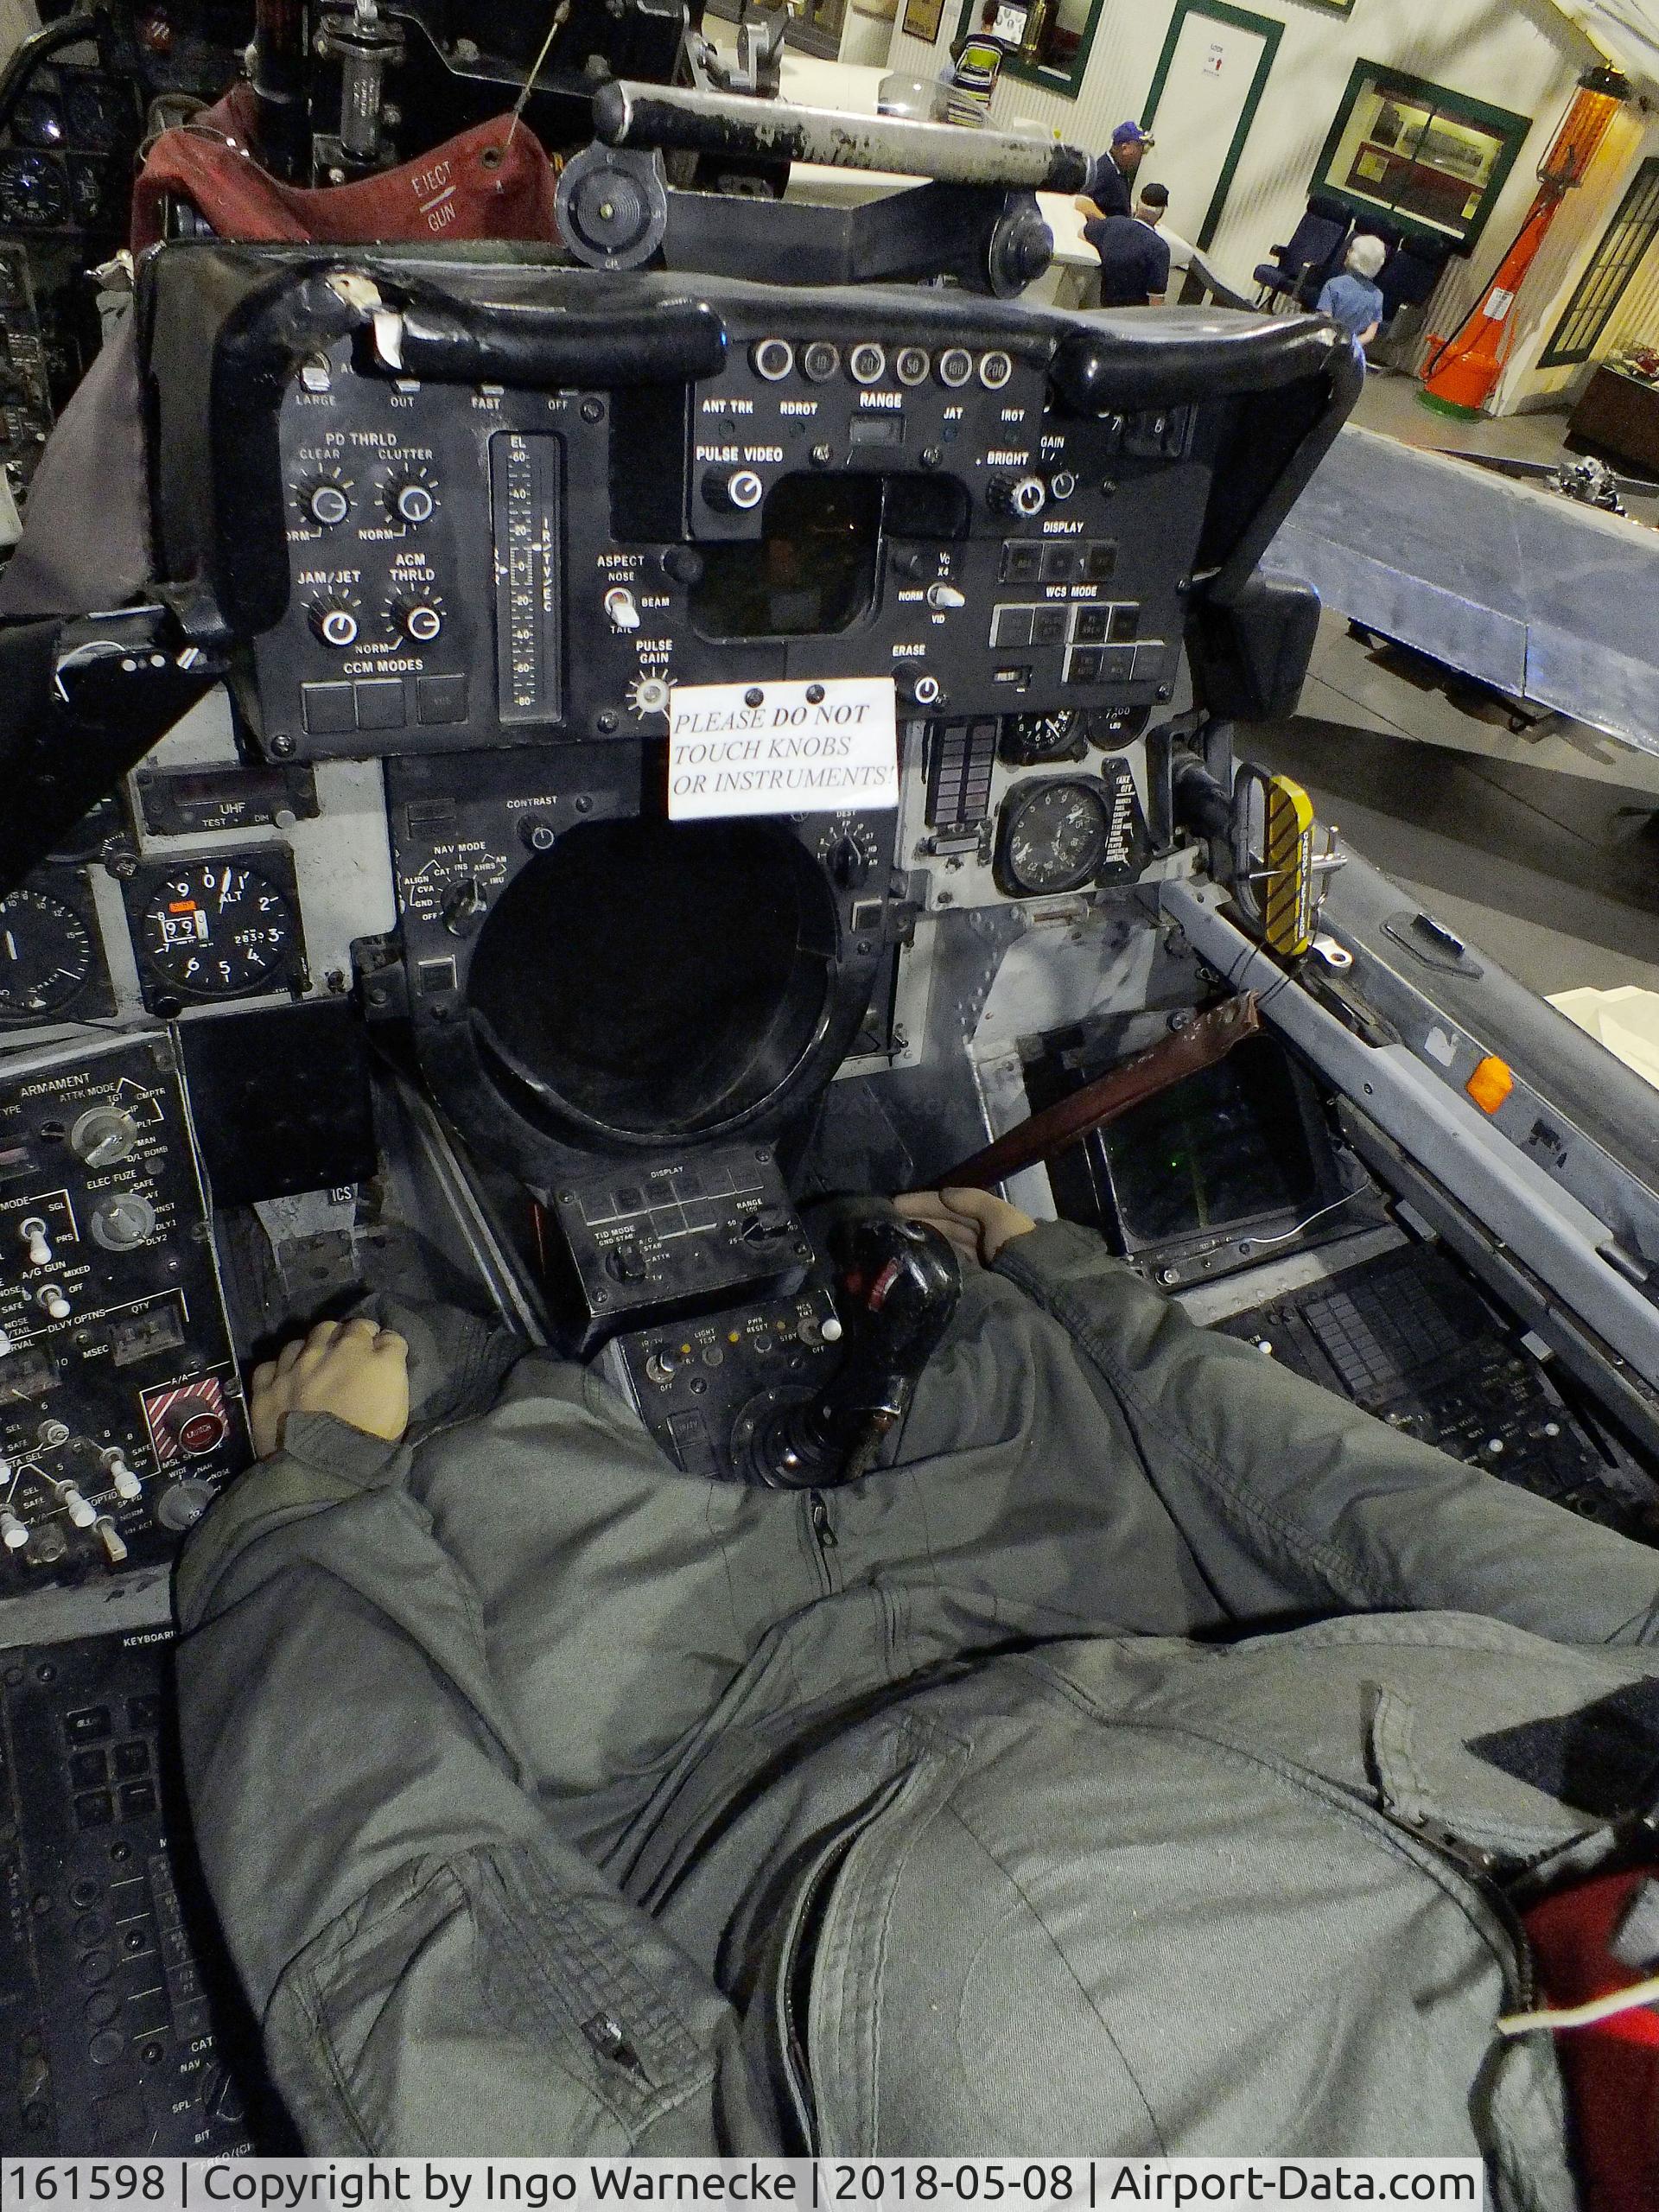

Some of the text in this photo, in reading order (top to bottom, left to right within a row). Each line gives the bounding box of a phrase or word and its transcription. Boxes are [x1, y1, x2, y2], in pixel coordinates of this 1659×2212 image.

[411, 161, 452, 198] EJECT
[427, 202, 456, 232] GUN
[296, 395, 336, 406] LARGE
[390, 396, 415, 408] OUT
[472, 397, 501, 409] FAST
[548, 399, 569, 410] OFF
[702, 400, 753, 414] ANT TRK
[860, 392, 902, 409] RANGE
[780, 401, 818, 416] RDROT
[943, 407, 964, 420] JAT
[1001, 409, 1025, 423] IROT
[326, 433, 397, 447] PD THRLD
[510, 435, 527, 448] EL
[1039, 436, 1065, 448] GAIN
[299, 448, 340, 461] CLEAR
[378, 448, 433, 461] CLUTTER
[696, 446, 784, 462] PULSE VIDEO
[986, 451, 1030, 466] BRIGHT
[513, 488, 527, 500] 40
[514, 524, 528, 537] 20
[1042, 521, 1084, 534] DISPLAY
[359, 529, 394, 541] NORM
[395, 553, 427, 568] ACM
[597, 555, 645, 569] ASPECT
[297, 569, 361, 585] JAM/JET
[390, 569, 435, 582] THRLD
[607, 570, 635, 582] NOSE
[897, 590, 924, 602] NORM
[1045, 584, 1098, 598] WCS MODE
[518, 594, 530, 607] 20
[641, 596, 671, 608] BEAM
[931, 613, 946, 625] VID
[518, 629, 531, 640] 40
[355, 642, 390, 655] NORM
[636, 639, 673, 652] PULSE
[892, 644, 926, 657] ERASE
[639, 652, 670, 664] GAIN
[343, 659, 424, 675] CCM MODES
[674, 704, 870, 734] PLEASE DO NOT
[675, 735, 852, 766] TOUCH KNOBS
[673, 766, 896, 796] OR INSTRUMENTS!
[219, 801, 246, 816] UHF
[506, 795, 559, 809] CONTRAST
[202, 817, 226, 828] TEST
[434, 841, 487, 855] NAV MODE
[433, 868, 452, 877] CAT
[454, 862, 468, 872] INS
[203, 874, 216, 889] 0
[238, 875, 245, 891] 1
[404, 875, 429, 887] ALIGN
[489, 876, 505, 886] IMU
[176, 882, 190, 898] 9
[416, 885, 435, 894] CVA
[221, 891, 243, 903] ALT
[258, 895, 271, 912] 2
[415, 899, 433, 909] GND
[156, 911, 166, 922] 8
[422, 912, 438, 922] OFF
[267, 927, 280, 944] 3
[247, 947, 260, 962] 4
[188, 957, 200, 972] 6
[219, 960, 232, 976] 5
[21, 1072, 91, 1097] ARMAMENT
[60, 1082, 117, 1103] ATTK MODE
[107, 1092, 124, 1103] TGT
[137, 1087, 166, 1101] CMPTR
[137, 1118, 152, 1128] PLT
[137, 1136, 156, 1147] MAN
[127, 1145, 169, 1163] D/L BOMB
[650, 1166, 684, 1179] DISPLAY
[86, 1169, 137, 1190] ELEC FUZE
[133, 1178, 155, 1190] SAFE
[332, 1186, 353, 1202] ICS
[0, 1196, 31, 1211] MODE
[48, 1202, 66, 1212] SGL
[155, 1202, 175, 1213] INST
[736, 1198, 763, 1210] RANGE
[156, 1219, 177, 1231] DLY1
[55, 1233, 74, 1243] PRS
[594, 1224, 636, 1240] TID MODE
[146, 1234, 168, 1247] DLY2
[598, 1233, 634, 1247] GND STAB
[639, 1236, 653, 1245] A/C
[644, 1243, 663, 1252] STAB
[652, 1253, 671, 1262] ATTK
[22, 1260, 67, 1280] A/G GUN
[63, 1264, 91, 1278] MIXED
[68, 1282, 84, 1294] OFF
[1, 1301, 24, 1314] SAFE
[130, 1301, 150, 1314] QTY
[3, 1316, 29, 1330] NOSE
[47, 1308, 106, 1333] DLVY OPTNS
[747, 1316, 763, 1325] PWR
[694, 1327, 715, 1339] LIGHT
[746, 1322, 768, 1333] RESET
[699, 1335, 717, 1345] TEST
[82, 1344, 110, 1359] MSEC
[812, 1344, 825, 1354] OFF
[171, 1373, 188, 1385] A/A
[659, 1382, 673, 1393] OFF
[41, 1401, 48, 1410] 6
[5, 1423, 22, 1434] SEL
[7, 1439, 29, 1452] SAFE
[132, 1444, 153, 1457] SAFE
[25, 1451, 43, 1464] SEL
[134, 1459, 148, 1469] SW
[162, 1459, 181, 1470] MSL
[22, 1484, 40, 1497] SEL
[22, 1496, 47, 1510] SAFE
[123, 1630, 176, 1648] KEYBOAR
[190, 2035, 214, 2053] CAT
[180, 2058, 201, 2074] NAV
[171, 2100, 192, 2114] SPL
[194, 2128, 211, 2144] BIT
